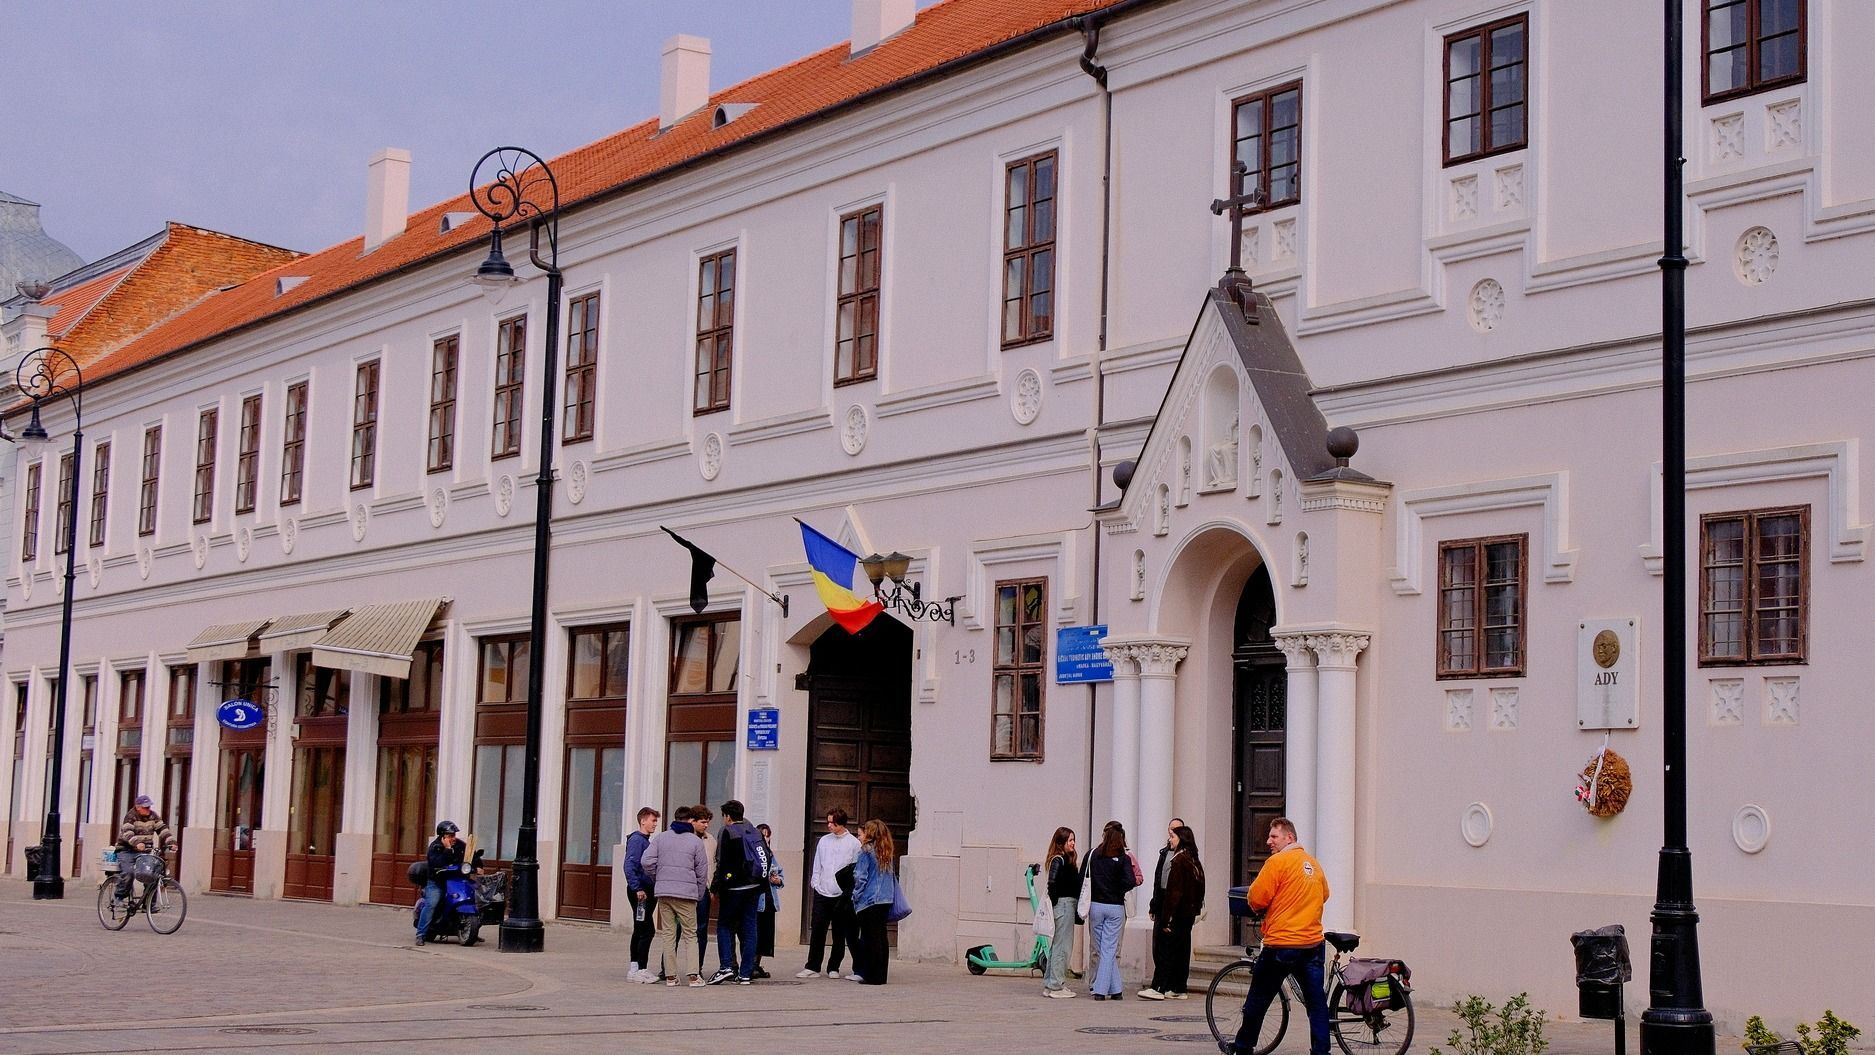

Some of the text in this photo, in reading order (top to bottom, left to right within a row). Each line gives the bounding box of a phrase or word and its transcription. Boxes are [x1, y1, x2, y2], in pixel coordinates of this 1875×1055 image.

[1595, 672, 1619, 685] ADY
[223, 701, 259, 712] SALON UNICA
[756, 846, 768, 878] adidas
